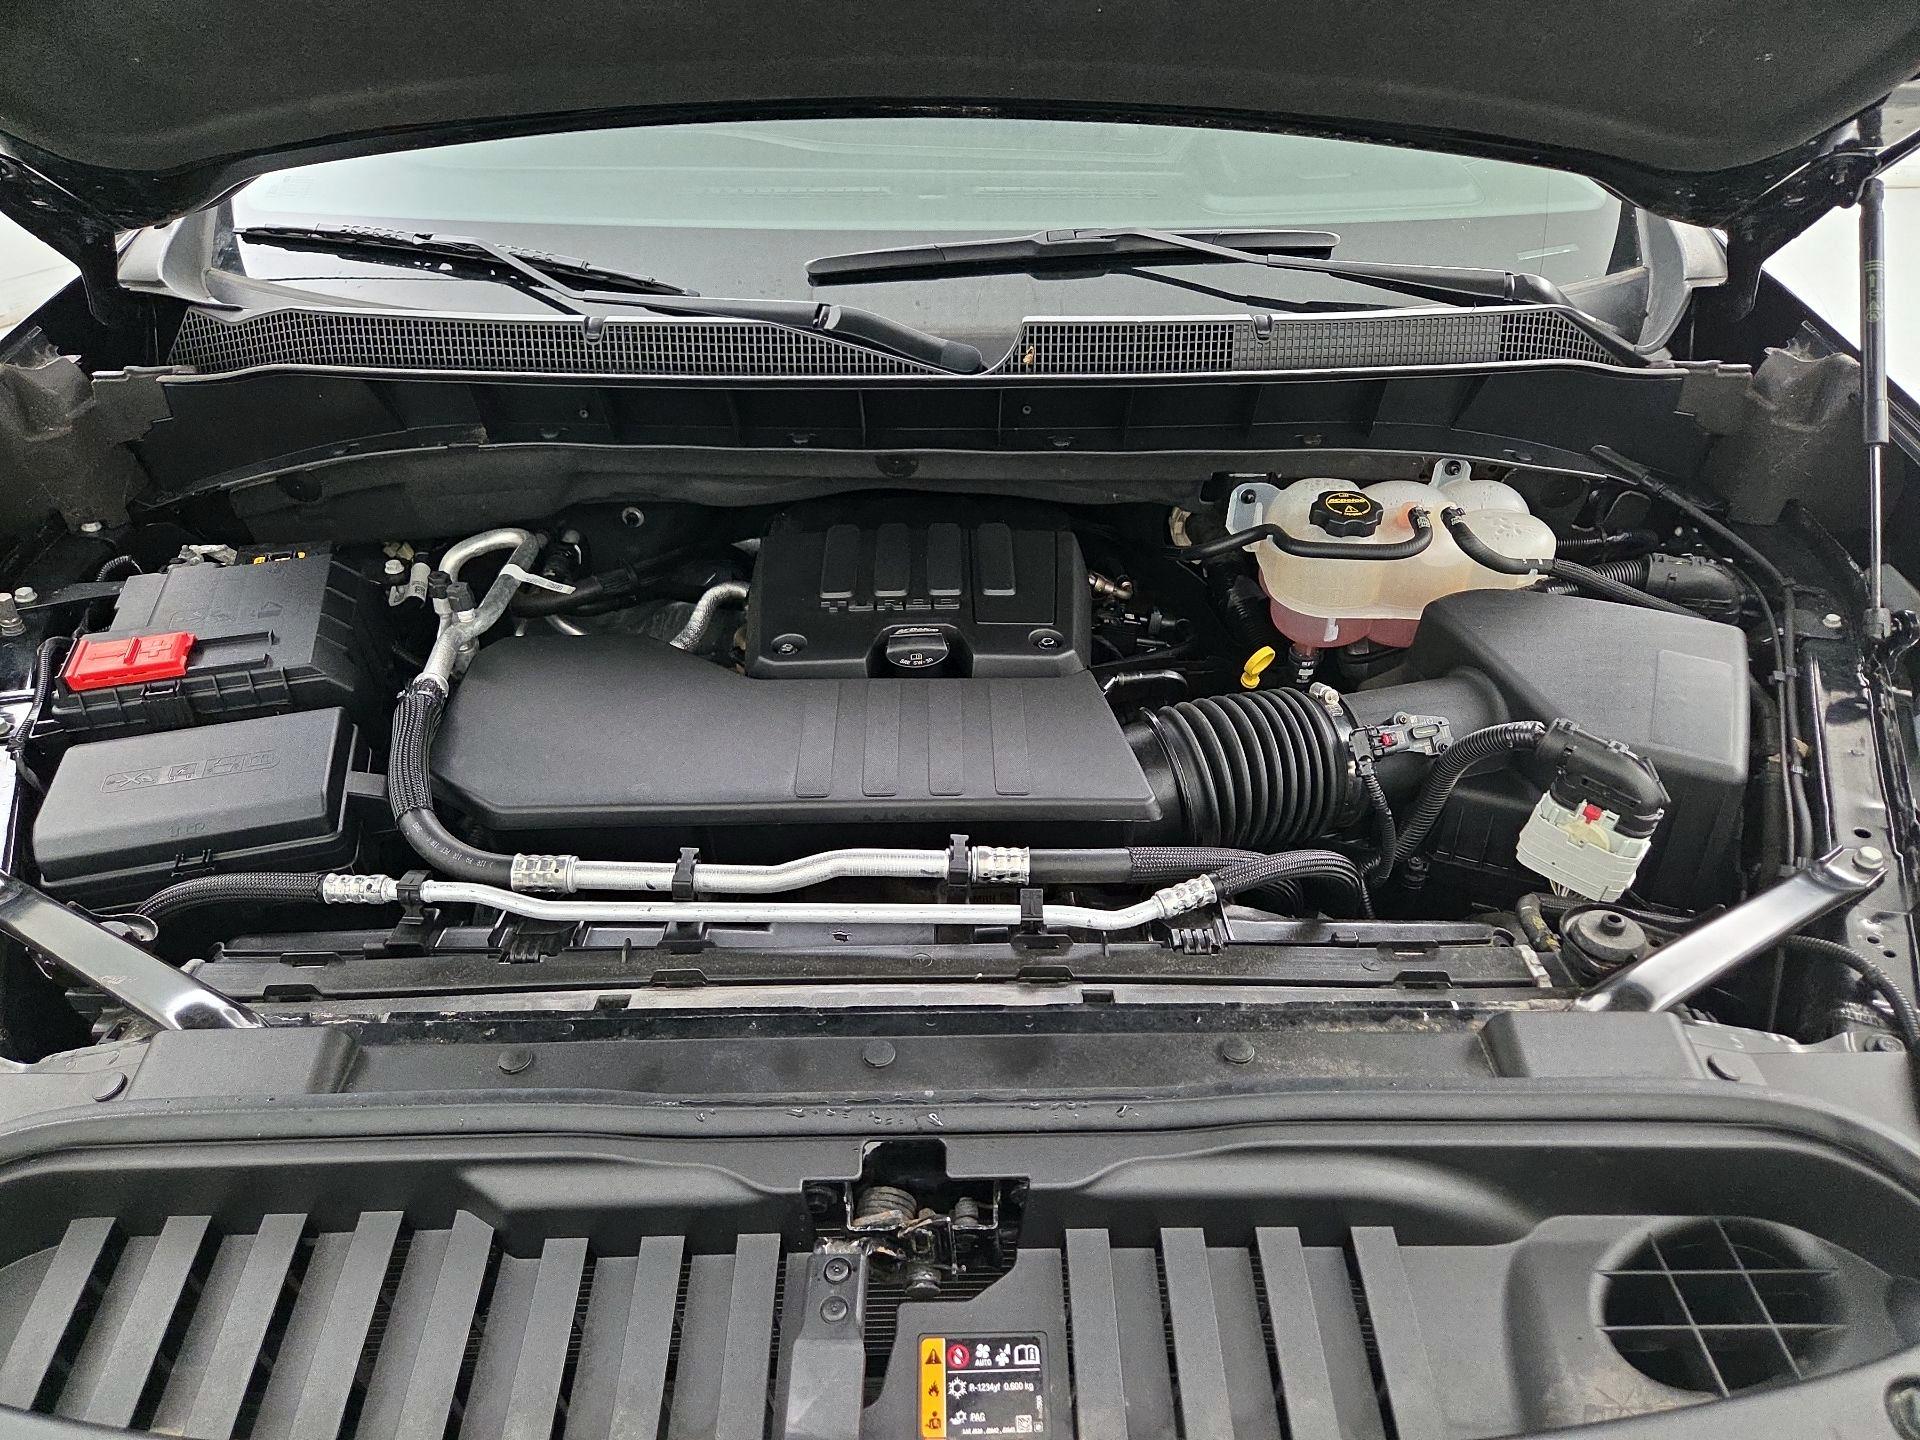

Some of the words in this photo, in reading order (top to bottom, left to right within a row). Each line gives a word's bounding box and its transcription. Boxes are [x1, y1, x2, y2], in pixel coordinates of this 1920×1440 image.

[974, 1358, 993, 1367] AUTO
[969, 1383, 1000, 1393] R-1234yf
[1024, 1380, 1035, 1392] kg
[970, 1412, 986, 1423] PAG
